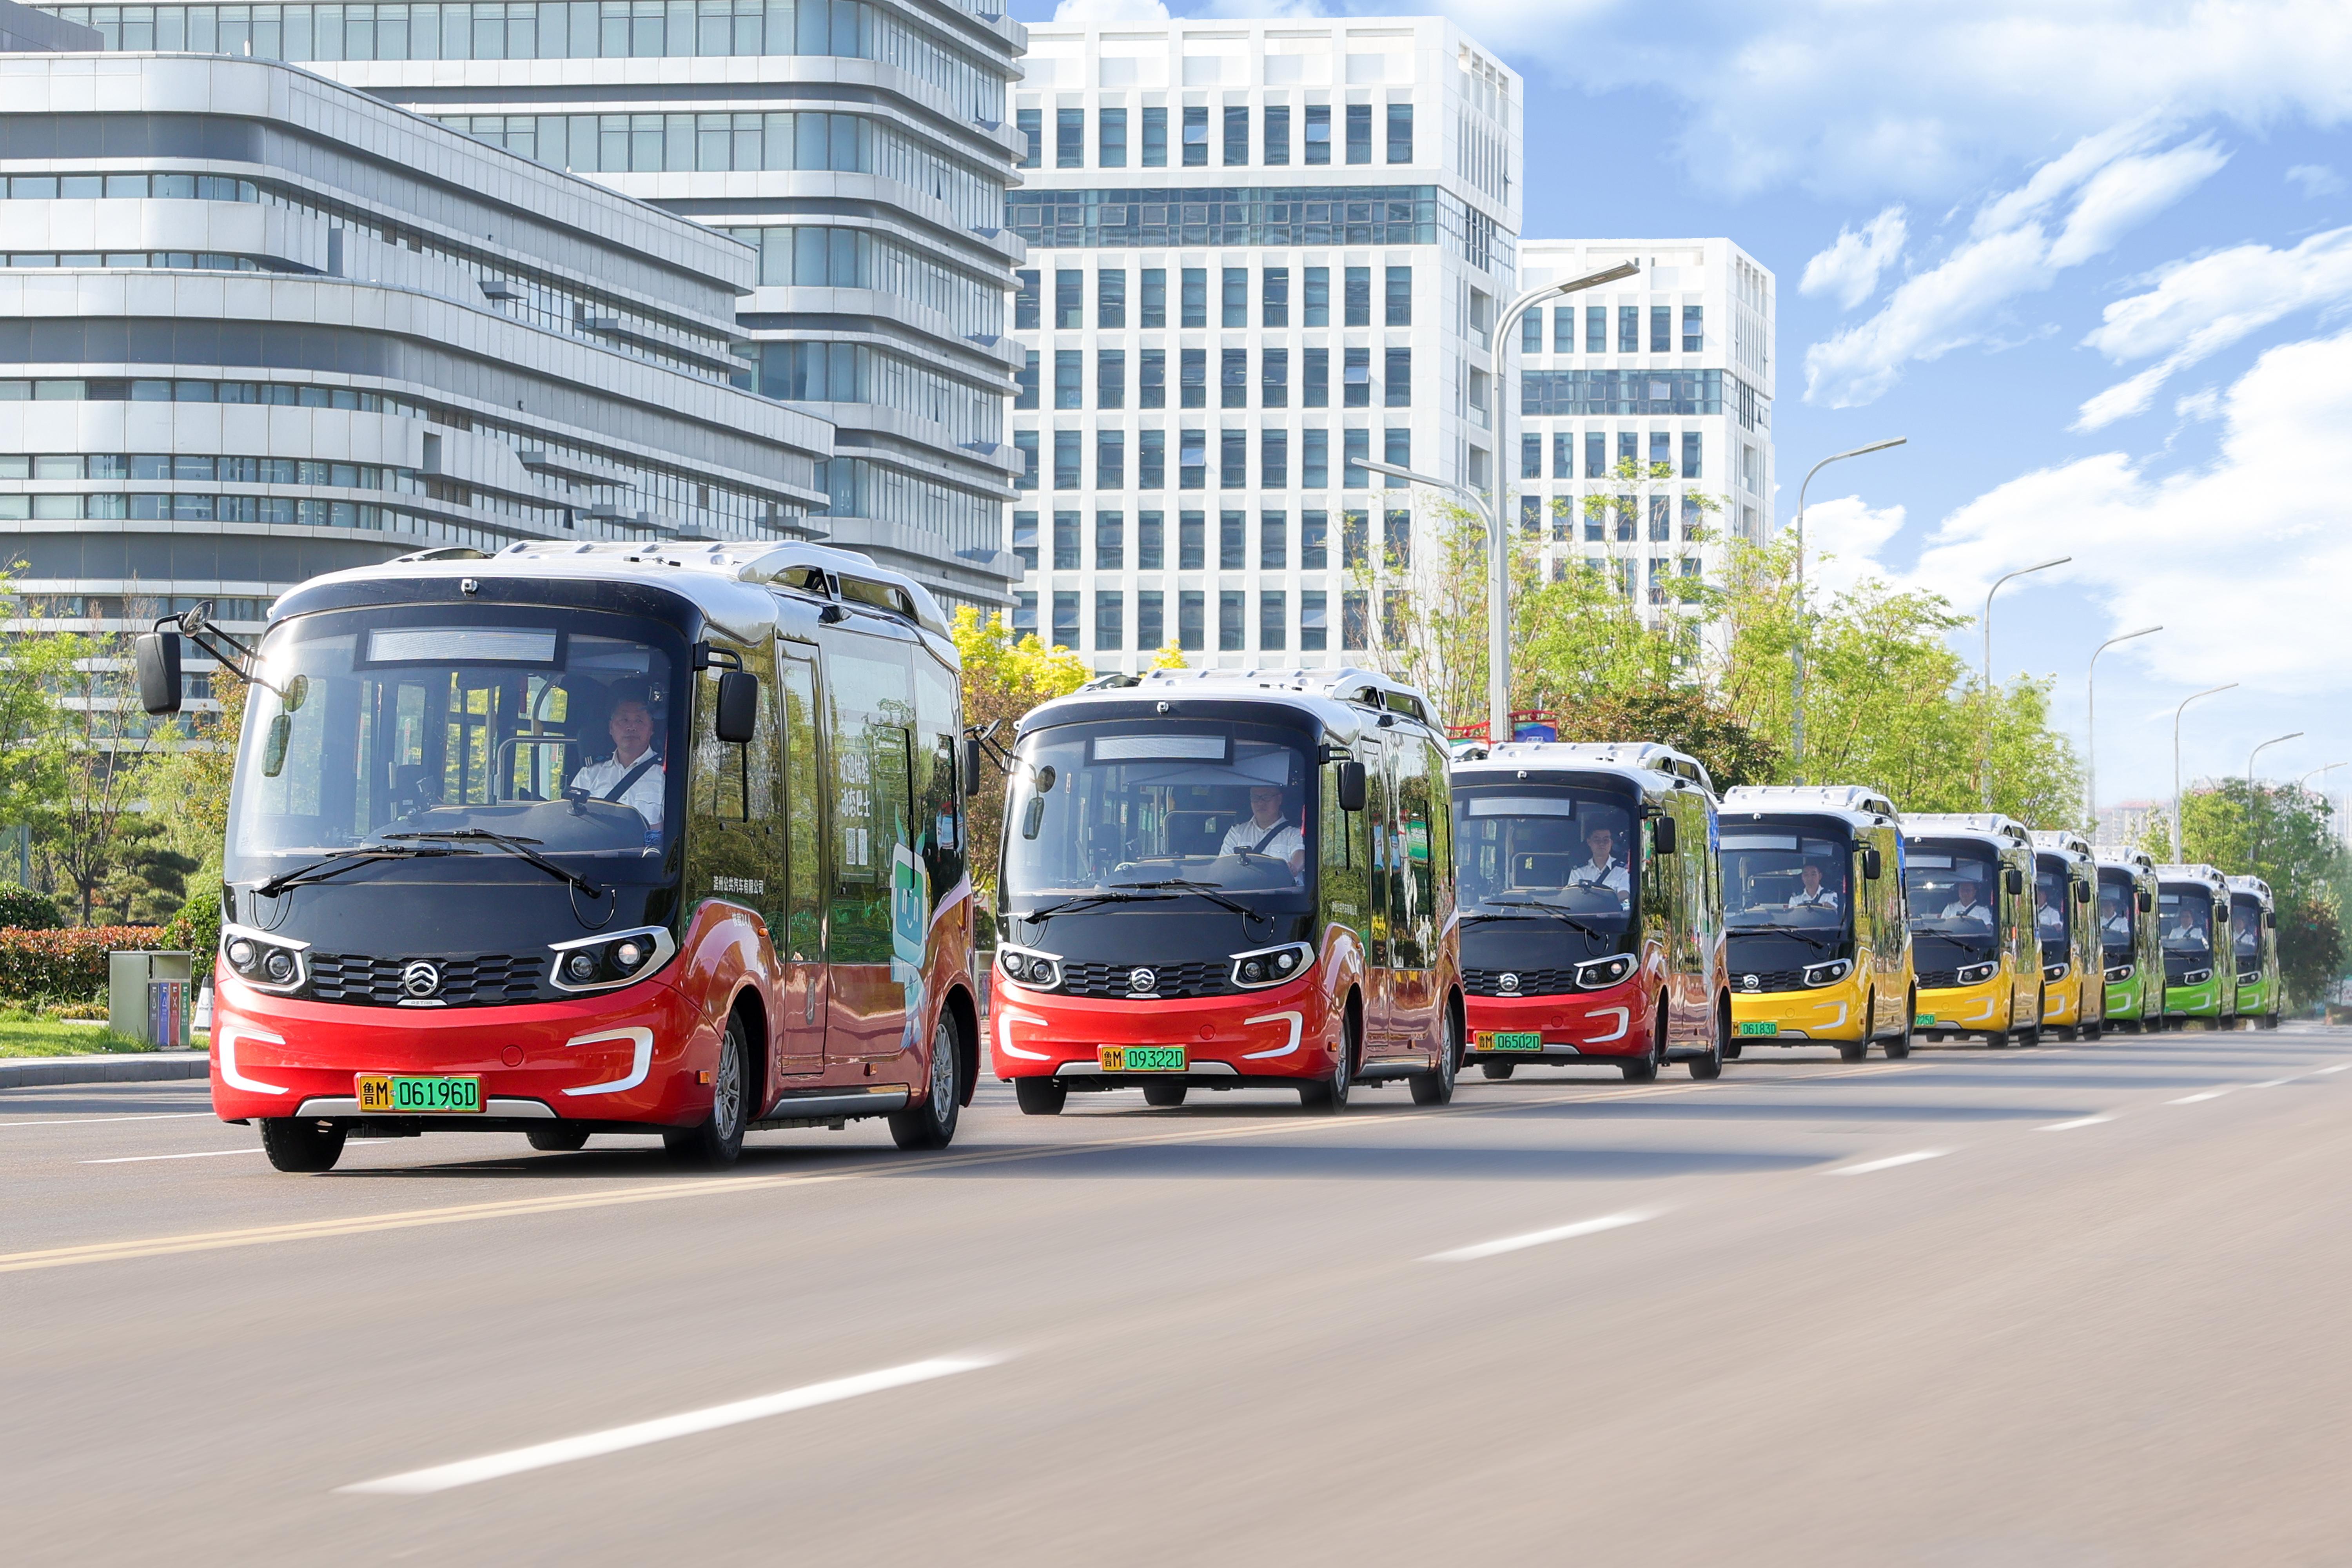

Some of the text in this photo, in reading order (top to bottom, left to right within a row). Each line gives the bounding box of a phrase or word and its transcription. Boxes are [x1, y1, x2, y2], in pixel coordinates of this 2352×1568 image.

[839, 752, 870, 785] 欢迎体验
[841, 786, 870, 817] 动态巴士
[713, 875, 764, 895] 滨州公共汽车有限公司
